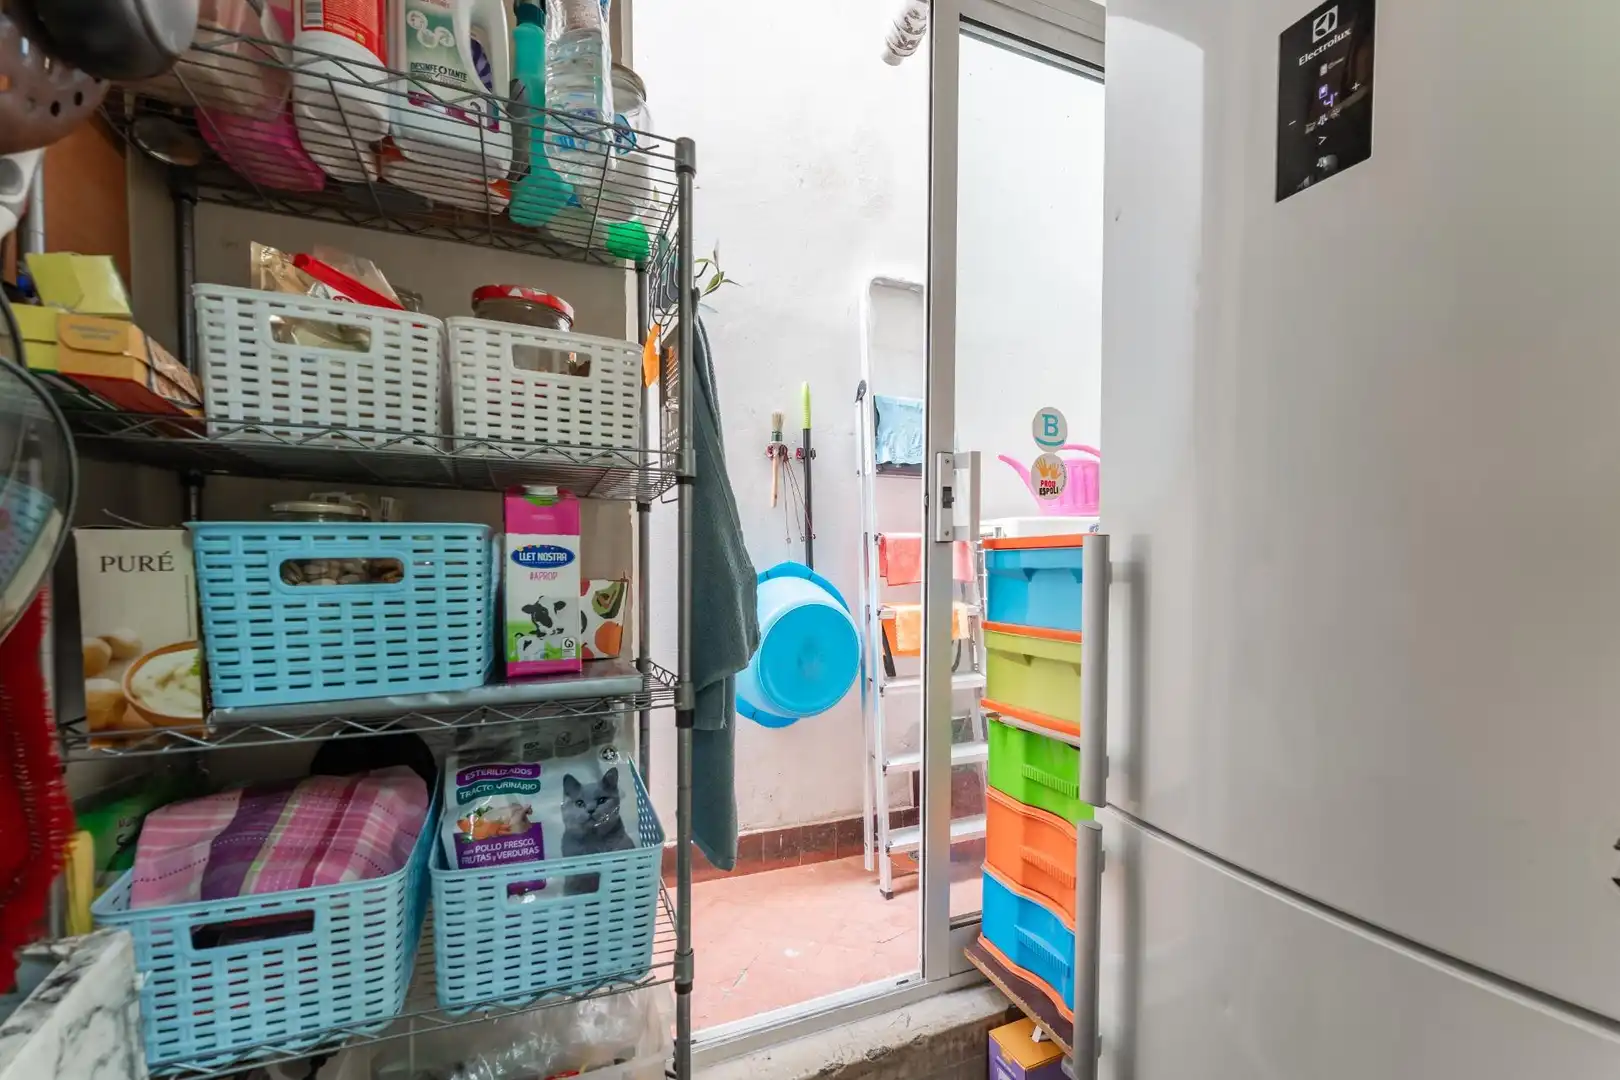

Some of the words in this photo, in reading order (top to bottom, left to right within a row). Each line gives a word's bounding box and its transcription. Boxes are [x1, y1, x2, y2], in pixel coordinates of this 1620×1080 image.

[1298, 27, 1352, 66] Electrolux
[1041, 413, 1060, 437] B
[100, 550, 175, 574] PURÉ
[519, 551, 537, 562] LLET
[537, 551, 568, 562] NOSTRA
[465, 767, 533, 781] ESTERILIZADOS
[459, 783, 494, 800] TRACTO
[461, 852, 492, 865] FRUTAS
[497, 846, 540, 860] VERDURAS
[475, 843, 502, 855] POLLO
